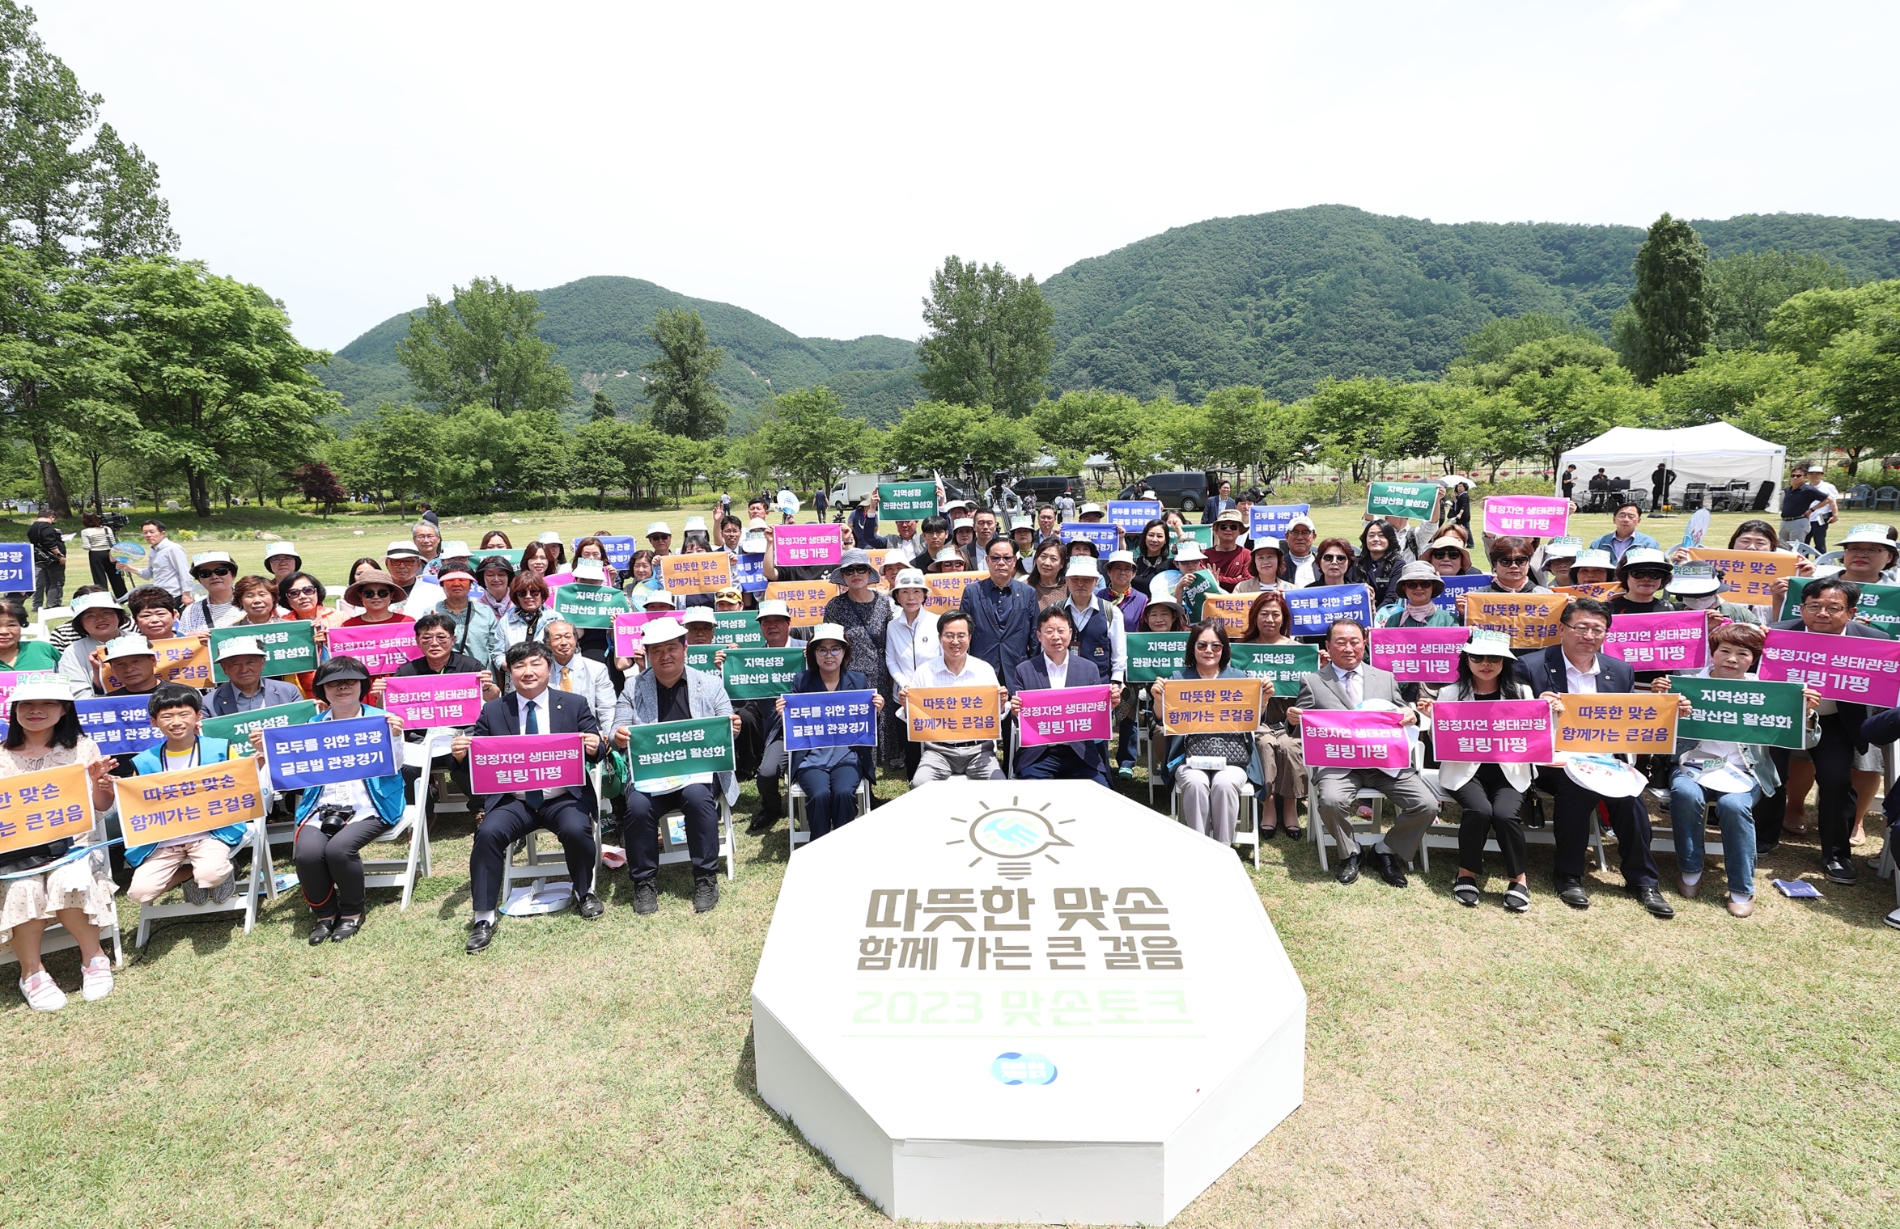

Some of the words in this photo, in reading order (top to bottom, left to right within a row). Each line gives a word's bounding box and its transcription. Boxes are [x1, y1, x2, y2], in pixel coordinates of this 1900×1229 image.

[893, 489, 922, 498] 지역성장
[1386, 485, 1419, 496] 지역성장
[883, 501, 910, 510] 관광산업
[912, 500, 933, 509] 활성화
[1405, 497, 1429, 509] 활성화
[1488, 504, 1524, 515] 청정자연
[1526, 505, 1565, 516] 생태관광
[1254, 512, 1274, 521] 모두를
[1277, 512, 1290, 520] 위한
[1255, 524, 1276, 533] 글로벌
[1500, 517, 1550, 531] 힐링가평
[777, 537, 806, 546] 청정자연
[808, 536, 839, 545] 생태관광
[609, 555, 630, 563] 광경기
[789, 548, 829, 560] 힐링가평
[674, 561, 699, 572] 따뜻한
[701, 560, 717, 570] 맞손
[737, 562, 751, 572] 두를
[1673, 565, 1712, 576] 맞손토크
[1705, 559, 1745, 572] 따뜻한
[1750, 561, 1777, 575] 맞손
[668, 577, 700, 588] 함께가는
[703, 575, 727, 586] 큰걸음
[932, 577, 960, 590] 따뜻한
[1747, 582, 1773, 595] 큰걸
[576, 592, 612, 602] 지역성장
[778, 591, 805, 601] 따뜻한
[808, 589, 826, 600] 맞손
[1570, 583, 1605, 598] 뜻한
[1215, 600, 1244, 611] 따뜻한
[1291, 597, 1319, 609] 모두를
[1321, 596, 1340, 608] 위한
[1343, 594, 1363, 606] 관광
[560, 605, 596, 615] 관광산업
[598, 605, 625, 615] 활성화
[809, 607, 826, 618] 큰걸
[1483, 603, 1520, 617] 따뜻한
[1524, 603, 1550, 616] 맞손
[1294, 613, 1321, 625] 글로벌
[618, 626, 642, 635] 청정자
[1473, 629, 1510, 643] 맞손토크
[1523, 623, 1558, 637] 큰걸음
[1606, 632, 1651, 643] 청정자연
[1654, 628, 1702, 641] 생태관광
[735, 633, 761, 643] 활성화
[333, 639, 376, 652] 청정자연
[1147, 641, 1187, 652] 지역성장
[1374, 643, 1418, 655] 청정자연
[166, 647, 194, 661] 맞손
[274, 646, 310, 660] 활성화
[1252, 653, 1295, 665] 지역성장
[1623, 646, 1685, 662] 힐링가평
[1765, 647, 1827, 665] 청정자연
[1831, 657, 1899, 673] 생태관광
[744, 657, 784, 668] 지역성장
[1132, 657, 1171, 668] 관광산업
[1391, 659, 1450, 674] 힐링가평
[17, 673, 70, 685] 맞손토크
[168, 665, 209, 680] 큰걸음
[729, 674, 769, 685] 관광산업
[1246, 670, 1278, 682] 광산업
[1786, 668, 1870, 692] 힐링가평
[388, 691, 431, 703] 청정자연
[434, 688, 478, 700] 생태관광
[1180, 690, 1216, 703] 따뜻한
[1219, 689, 1244, 701] 맞손
[1701, 689, 1766, 705] 지역성장
[923, 698, 957, 710] 따뜻한
[960, 696, 983, 709] 맞손
[1021, 705, 1062, 718] 청정자연
[1065, 701, 1107, 714] 생태관광
[121, 709, 147, 721] 위한
[405, 704, 463, 720] 힐링가평
[790, 706, 821, 719] 모두를
[825, 704, 845, 716] 위한
[848, 703, 869, 715] 관광
[1169, 711, 1214, 724] 함께가는
[1219, 708, 1254, 722] 큰걸음
[1578, 706, 1623, 720] 따뜻한
[1628, 706, 1657, 720] 맞손
[913, 718, 957, 732] 함께가는
[962, 716, 995, 730] 큰걸음
[1037, 718, 1092, 735] 힐링가평
[1438, 719, 1488, 731] 청정자연
[1492, 718, 1547, 730] 생태관광
[1742, 711, 1793, 729] 활성화
[125, 727, 165, 740] 관광경
[793, 725, 824, 738] 글로벌
[827, 721, 869, 735] 관광경기
[1305, 726, 1352, 739] 청정자연
[1354, 728, 1403, 739] 생태관광
[1562, 727, 1620, 742] 함께가는
[1626, 727, 1668, 742] 큰걸음
[276, 738, 318, 754] 모두를
[323, 734, 351, 748] 위한
[354, 731, 382, 745] 관광
[656, 729, 705, 745] 지역성장
[1325, 743, 1388, 759] 힐링가평
[1458, 737, 1527, 753] 힐링가평
[475, 753, 525, 766] 청정자연
[529, 749, 579, 762] 생태관광
[638, 750, 687, 765] 관광산업
[690, 746, 726, 759] 활성화
[280, 760, 324, 776] 글로벌
[328, 751, 384, 770] 관광경기
[495, 766, 562, 784] 힐링가평
[19, 783, 60, 805] 맞손
[143, 781, 196, 802] 따뜻한
[201, 774, 235, 792] 맞손
[26, 804, 84, 831] 큰걸음
[129, 806, 201, 832] 함께가는
[207, 793, 256, 816] 큰걸음
[865, 885, 1036, 932] 따뜻한
[1053, 886, 1171, 931] 맞손
[857, 935, 939, 970] 함께
[952, 936, 1032, 970] 가는
[1046, 936, 1087, 970] 큰
[1099, 935, 1184, 970] 걸음
[852, 990, 984, 1025] 2023
[1001, 989, 1195, 1028] 맞손토크
